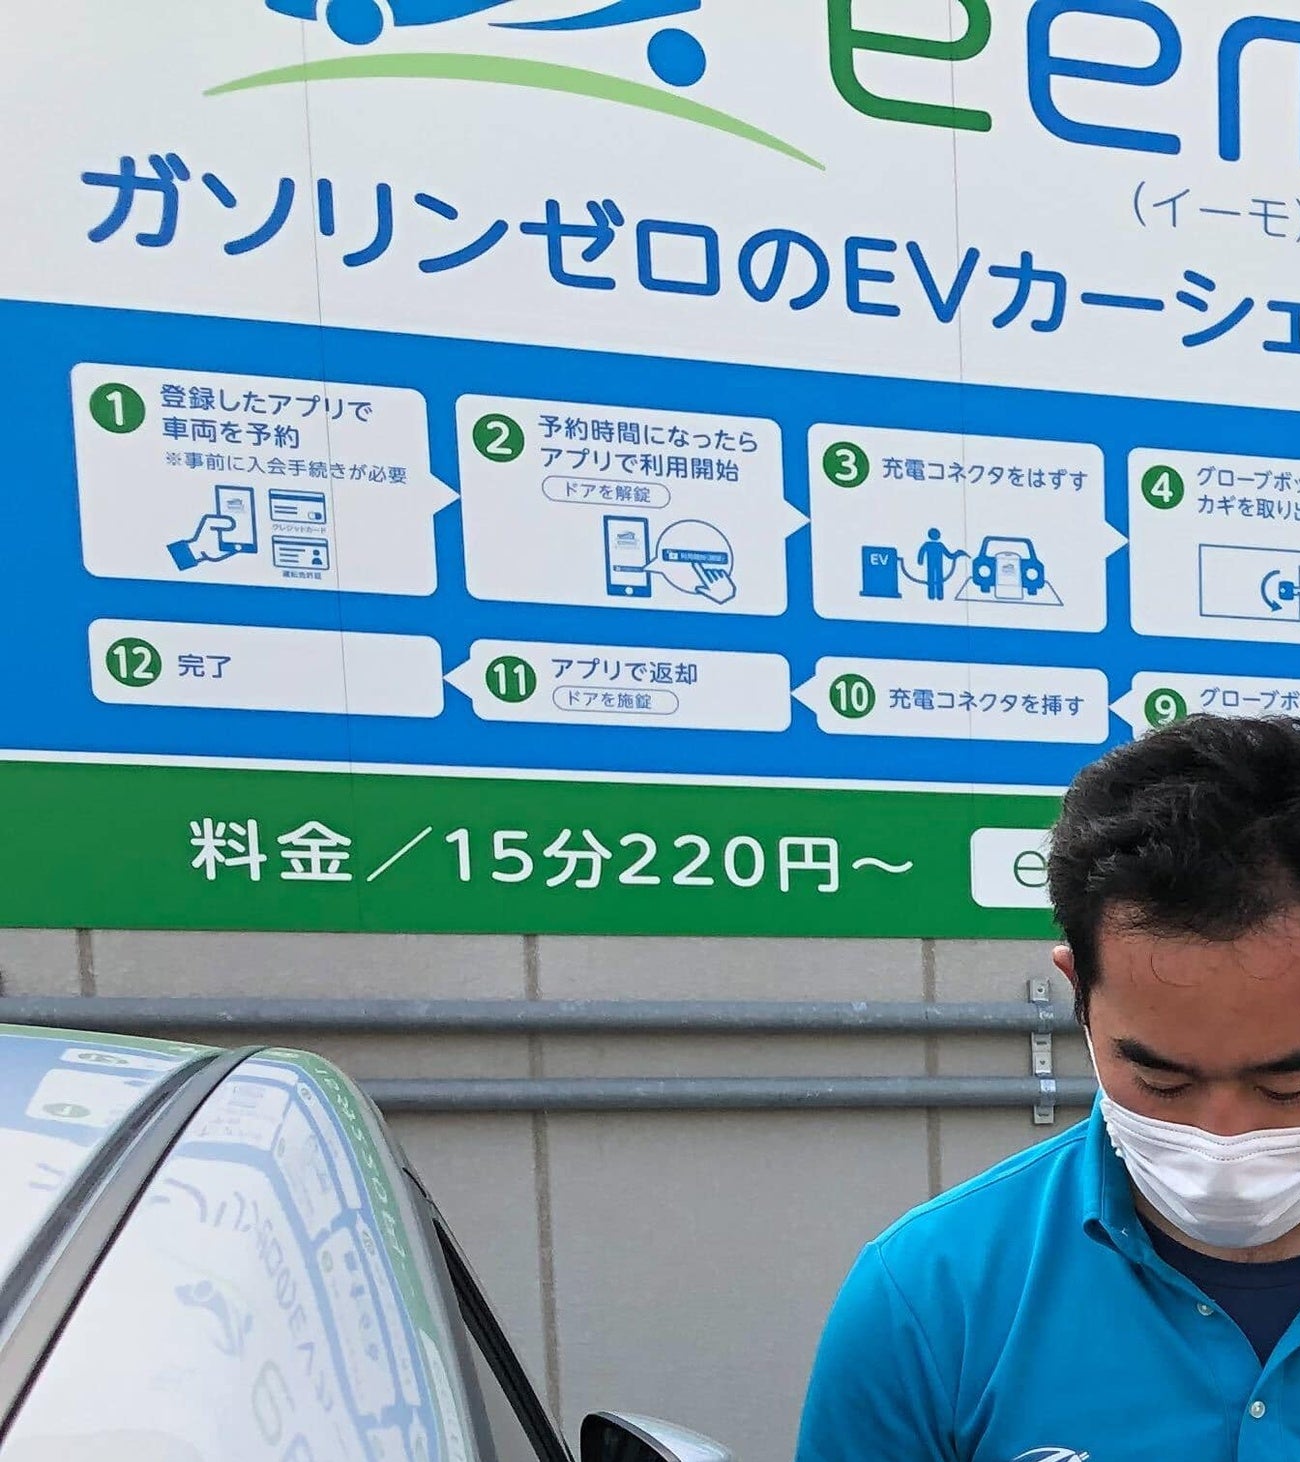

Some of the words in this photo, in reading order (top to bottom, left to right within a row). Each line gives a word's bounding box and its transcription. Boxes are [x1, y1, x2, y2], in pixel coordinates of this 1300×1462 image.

[106, 392, 125, 425] 1
[160, 384, 374, 423] 登録したアプリで
[161, 415, 301, 450] 車両を予約
[486, 421, 512, 454] 2
[537, 414, 759, 454] 予約時間になったら
[539, 446, 741, 483] アプリで利用開始
[834, 449, 858, 481] 3
[882, 456, 1089, 492] 充電コネクタをはずす
[565, 482, 652, 503] ドアを解錠
[1150, 472, 1175, 503] 4
[870, 553, 890, 566] EV
[112, 645, 156, 680] 12
[177, 653, 232, 679] 完了
[552, 658, 697, 685] アプリで返却
[493, 662, 527, 697] 11
[834, 680, 869, 712] 10
[889, 687, 1085, 717] 充電コネクタを挿す
